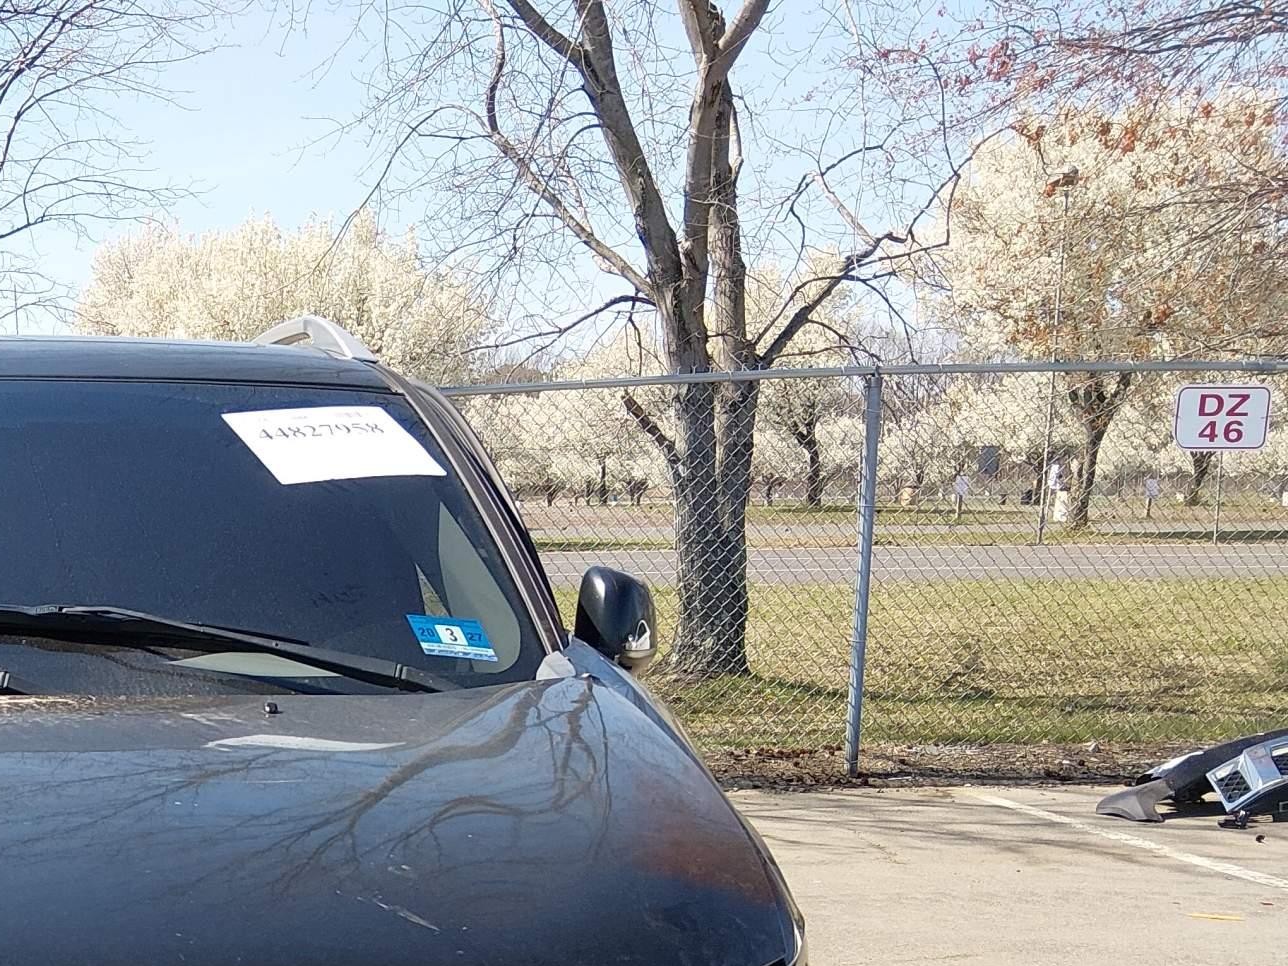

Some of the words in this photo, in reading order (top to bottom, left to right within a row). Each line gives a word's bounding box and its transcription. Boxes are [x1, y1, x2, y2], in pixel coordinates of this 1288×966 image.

[1198, 393, 1251, 417] DZ
[1198, 420, 1244, 443] 46
[418, 627, 436, 638] 20
[445, 627, 458, 642] 3
[467, 632, 482, 642] 27
